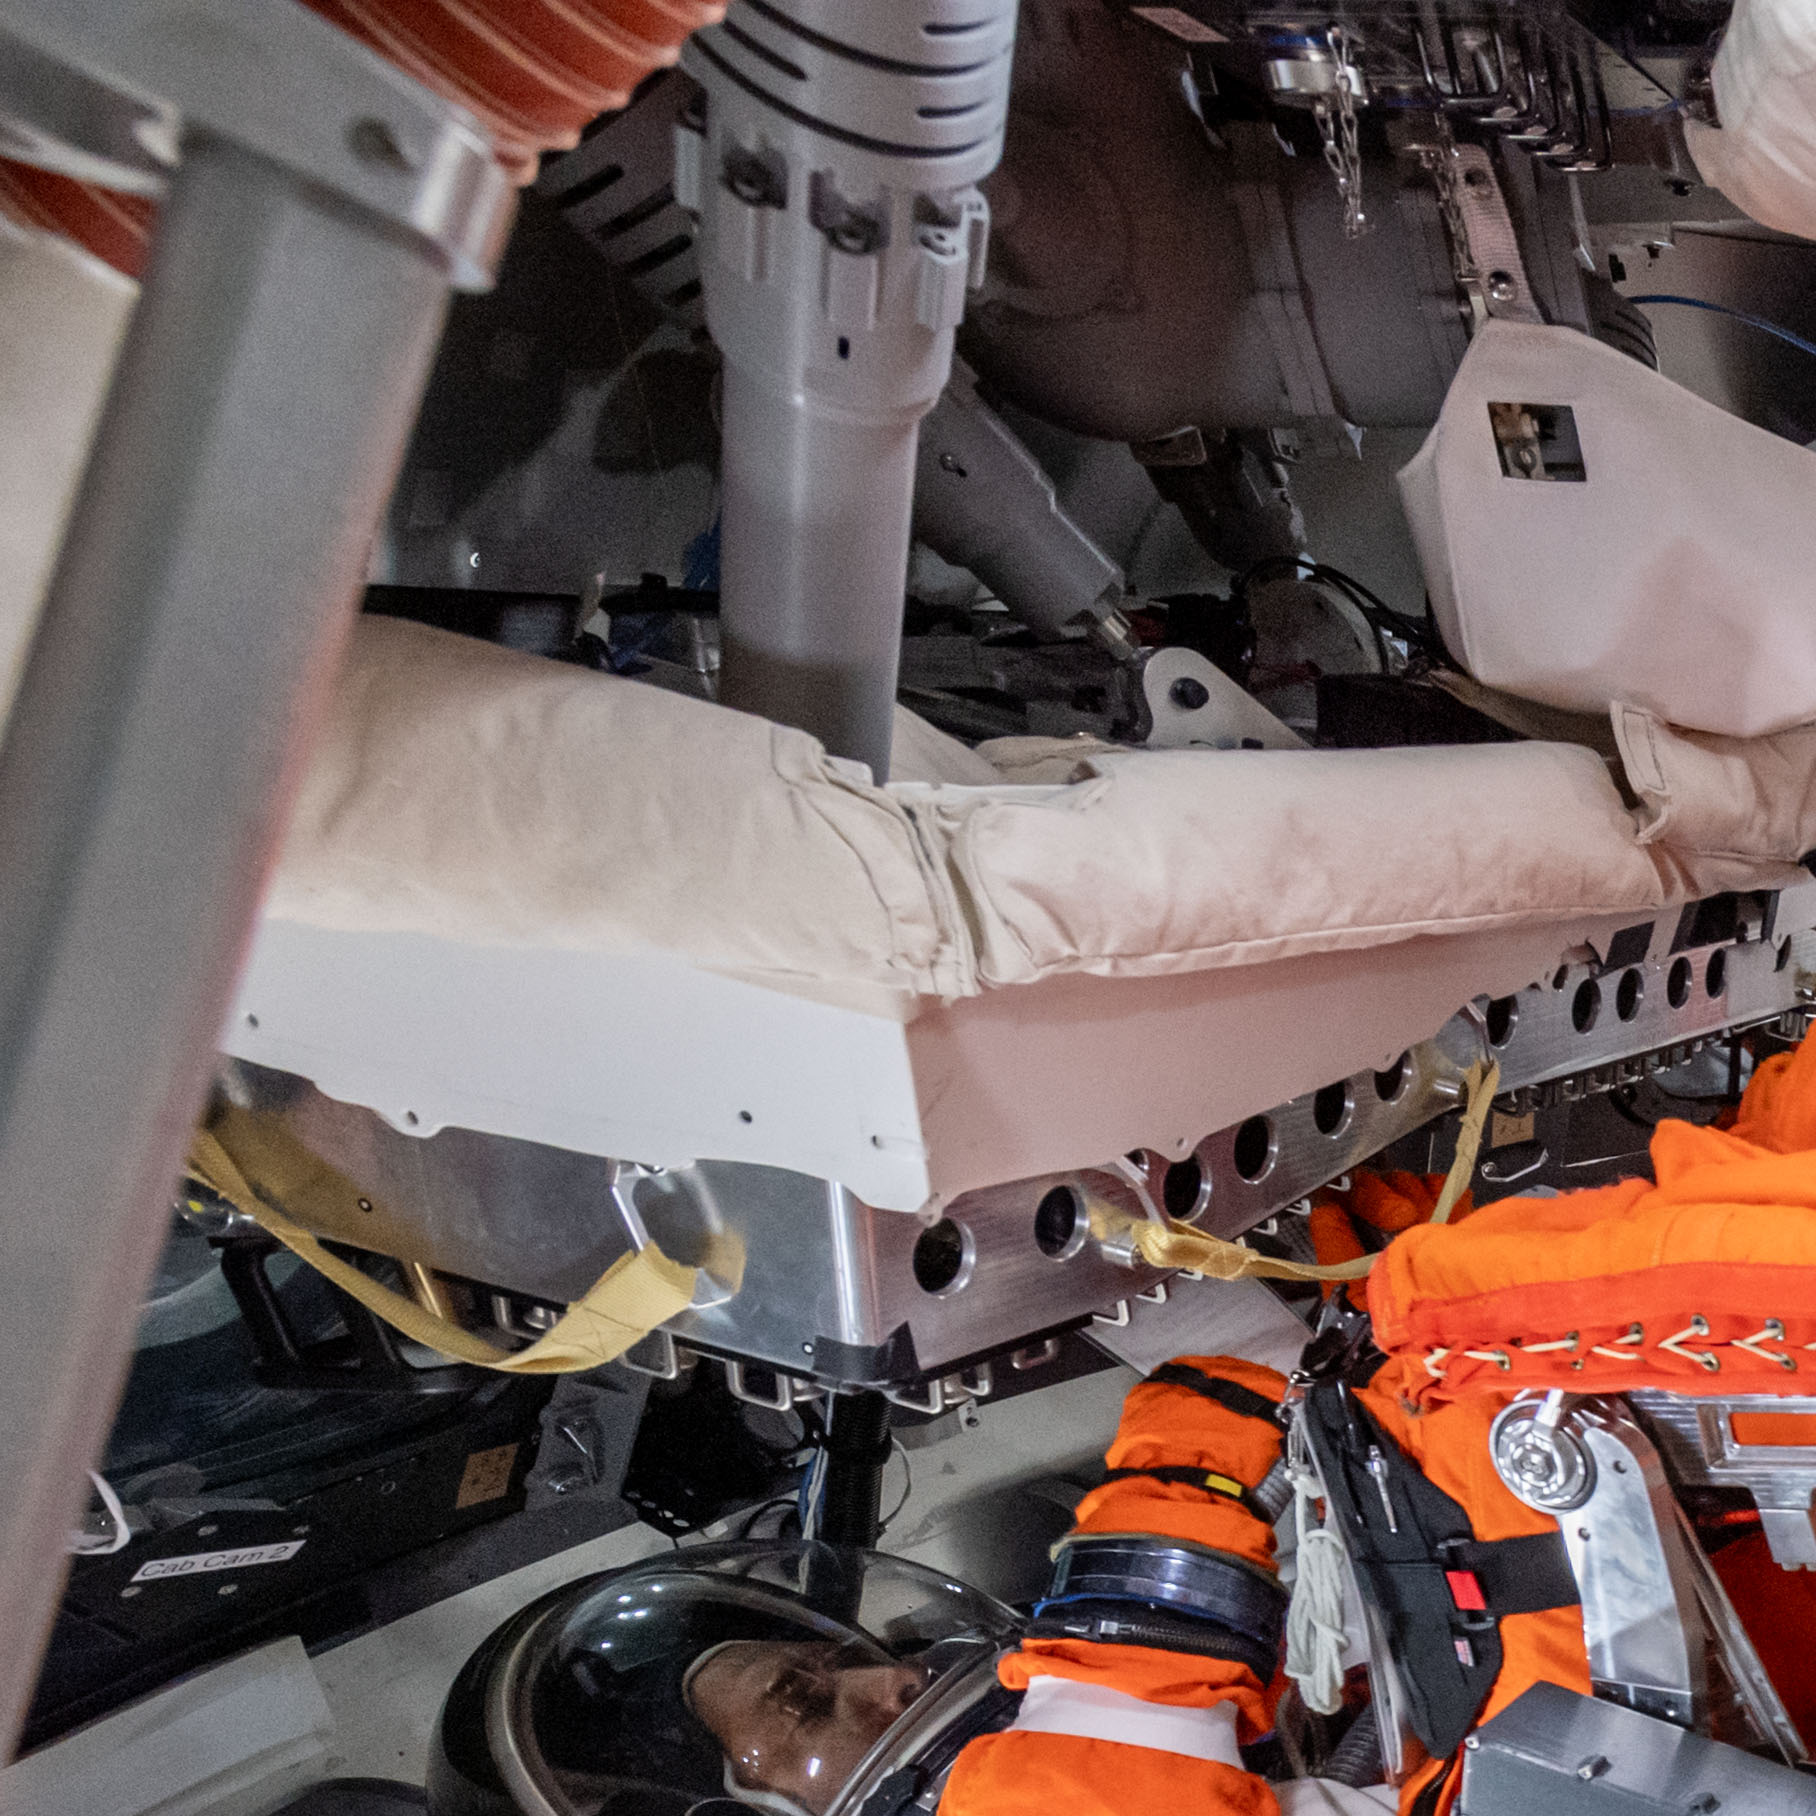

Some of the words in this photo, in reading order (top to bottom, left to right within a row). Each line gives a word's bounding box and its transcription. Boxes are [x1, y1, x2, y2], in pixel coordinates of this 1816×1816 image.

[141, 1558, 196, 1578] Cab
[200, 1550, 264, 1569] Cam
[271, 1545, 290, 1559] 2
